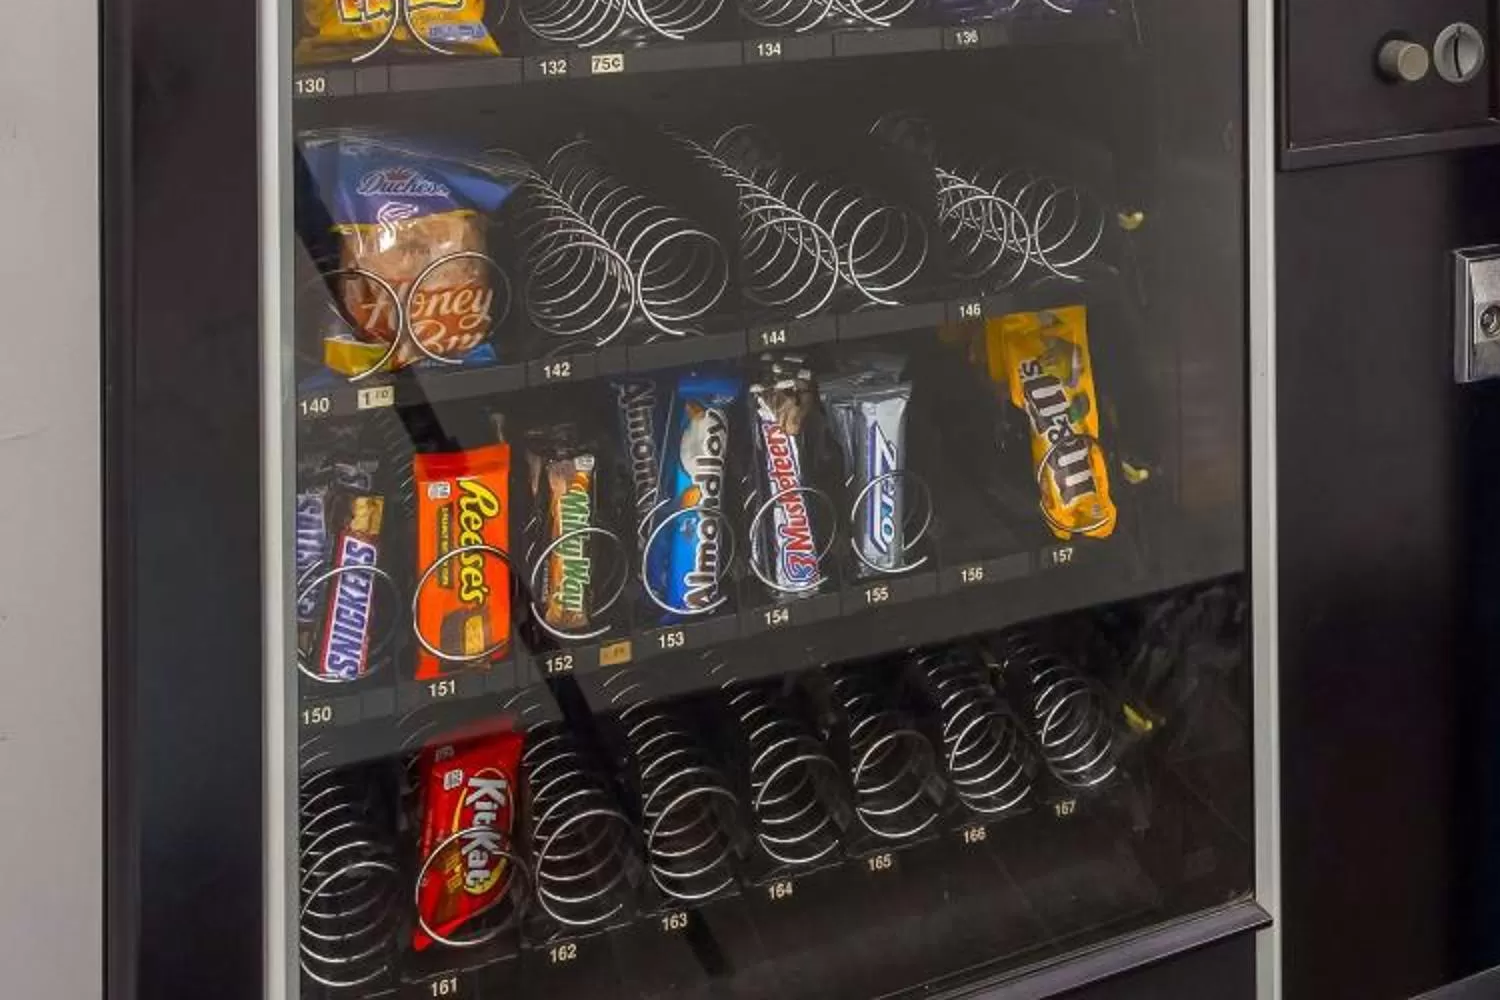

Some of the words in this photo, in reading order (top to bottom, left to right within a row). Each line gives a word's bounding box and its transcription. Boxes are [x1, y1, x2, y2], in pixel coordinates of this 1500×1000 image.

[757, 42, 782, 57] 134
[539, 59, 568, 76] 132
[295, 77, 326, 94] 130
[959, 304, 982, 319] 146
[761, 330, 787, 346] 144
[543, 362, 572, 379] 142
[300, 398, 330, 416] 140
[762, 423, 814, 553] Musketeers
[552, 489, 591, 558] Milky
[454, 477, 500, 606] Reese's
[683, 472, 722, 611] Almond
[1052, 548, 1074, 564] 157
[554, 556, 591, 612] Way
[961, 567, 984, 583] 156
[864, 587, 889, 603] 155
[326, 537, 377, 681] SNICKERS
[764, 608, 789, 625] 154
[657, 631, 685, 649] 153
[545, 655, 574, 673] 152
[428, 680, 456, 697] 151
[302, 706, 332, 725] 150
[465, 777, 508, 829] Kit
[963, 827, 987, 844] 166
[461, 829, 502, 886] Kat
[868, 853, 892, 871] 165
[768, 881, 793, 900] 164
[661, 912, 688, 931] 163
[550, 943, 578, 963] 162
[431, 977, 459, 997] 161
